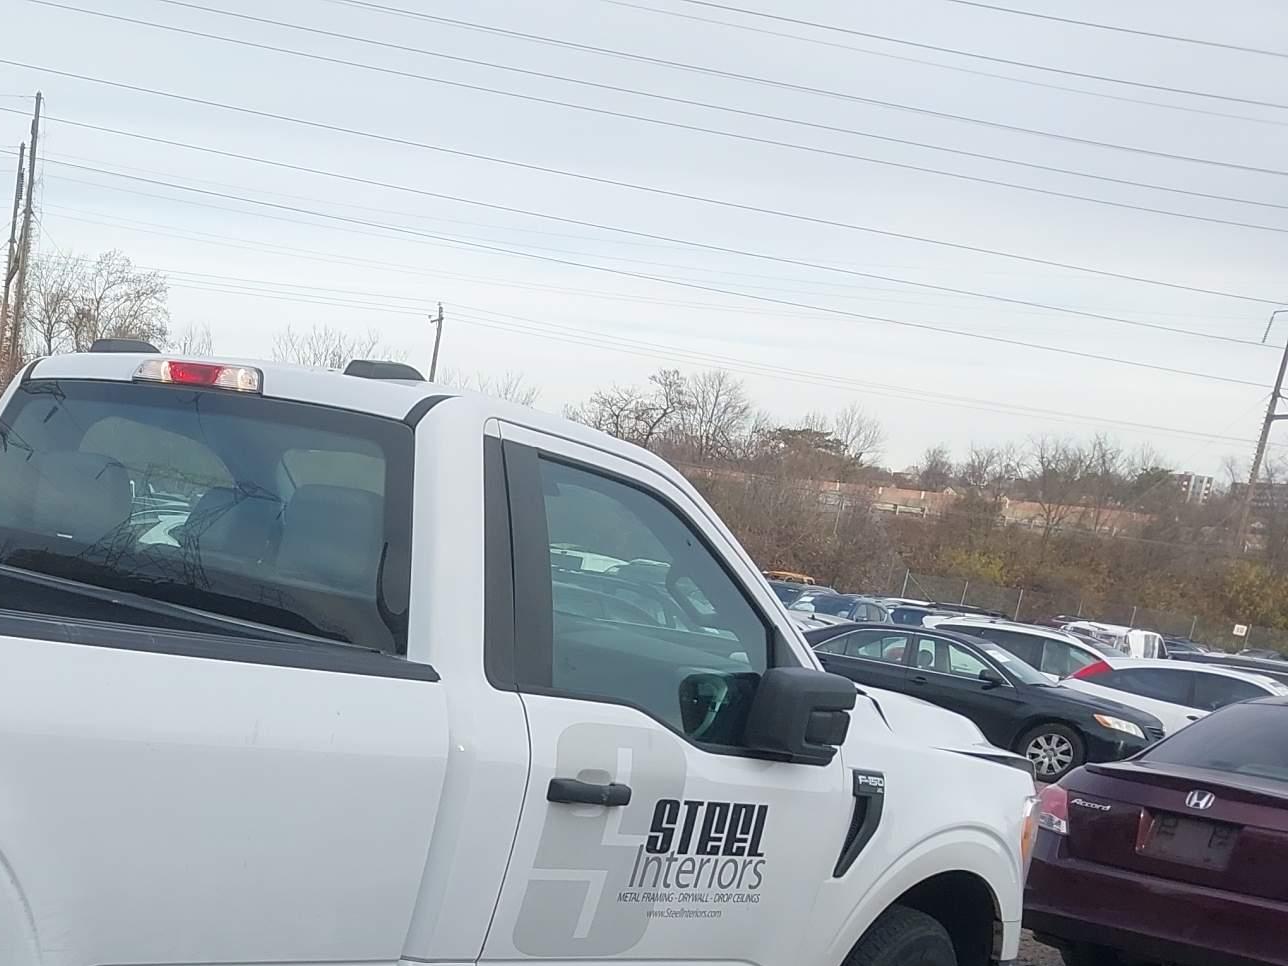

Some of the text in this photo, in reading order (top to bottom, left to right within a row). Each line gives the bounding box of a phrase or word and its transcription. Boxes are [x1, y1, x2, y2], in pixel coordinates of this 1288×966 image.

[857, 774, 884, 787] F-150
[1070, 798, 1111, 811] Accord
[645, 799, 768, 857] STEEL
[628, 844, 766, 890] Interiors
[617, 892, 641, 903] METAL
[641, 892, 675, 903] FRAMING
[678, 893, 708, 903] DRYWALL
[713, 893, 733, 904] DROP
[733, 893, 761, 904] CEILINGS
[646, 908, 722, 919] www.SteelInteriors.com
